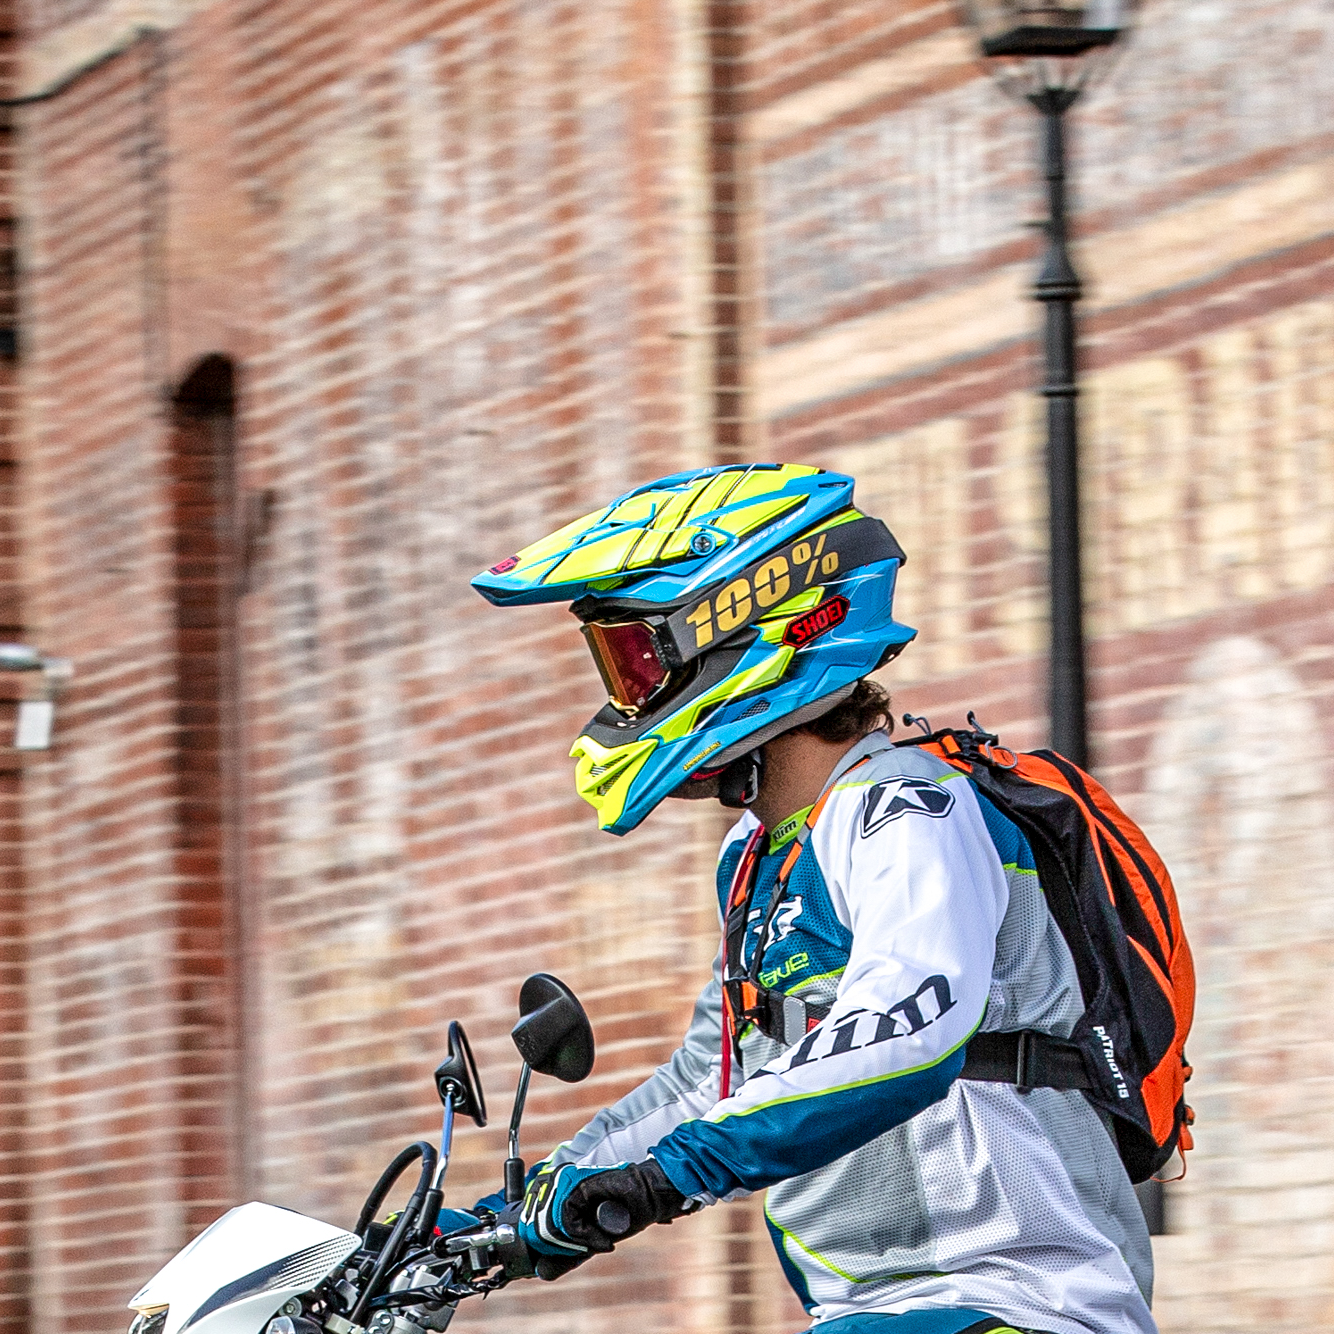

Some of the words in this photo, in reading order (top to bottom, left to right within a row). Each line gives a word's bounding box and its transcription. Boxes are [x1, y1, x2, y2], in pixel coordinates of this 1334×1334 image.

[685, 532, 840, 649] 100%
[790, 600, 844, 643] SHOEI
[747, 973, 958, 1081] lim
[1092, 1025, 1125, 1081] PATRIOT
[1116, 1082, 1130, 1099] 15
